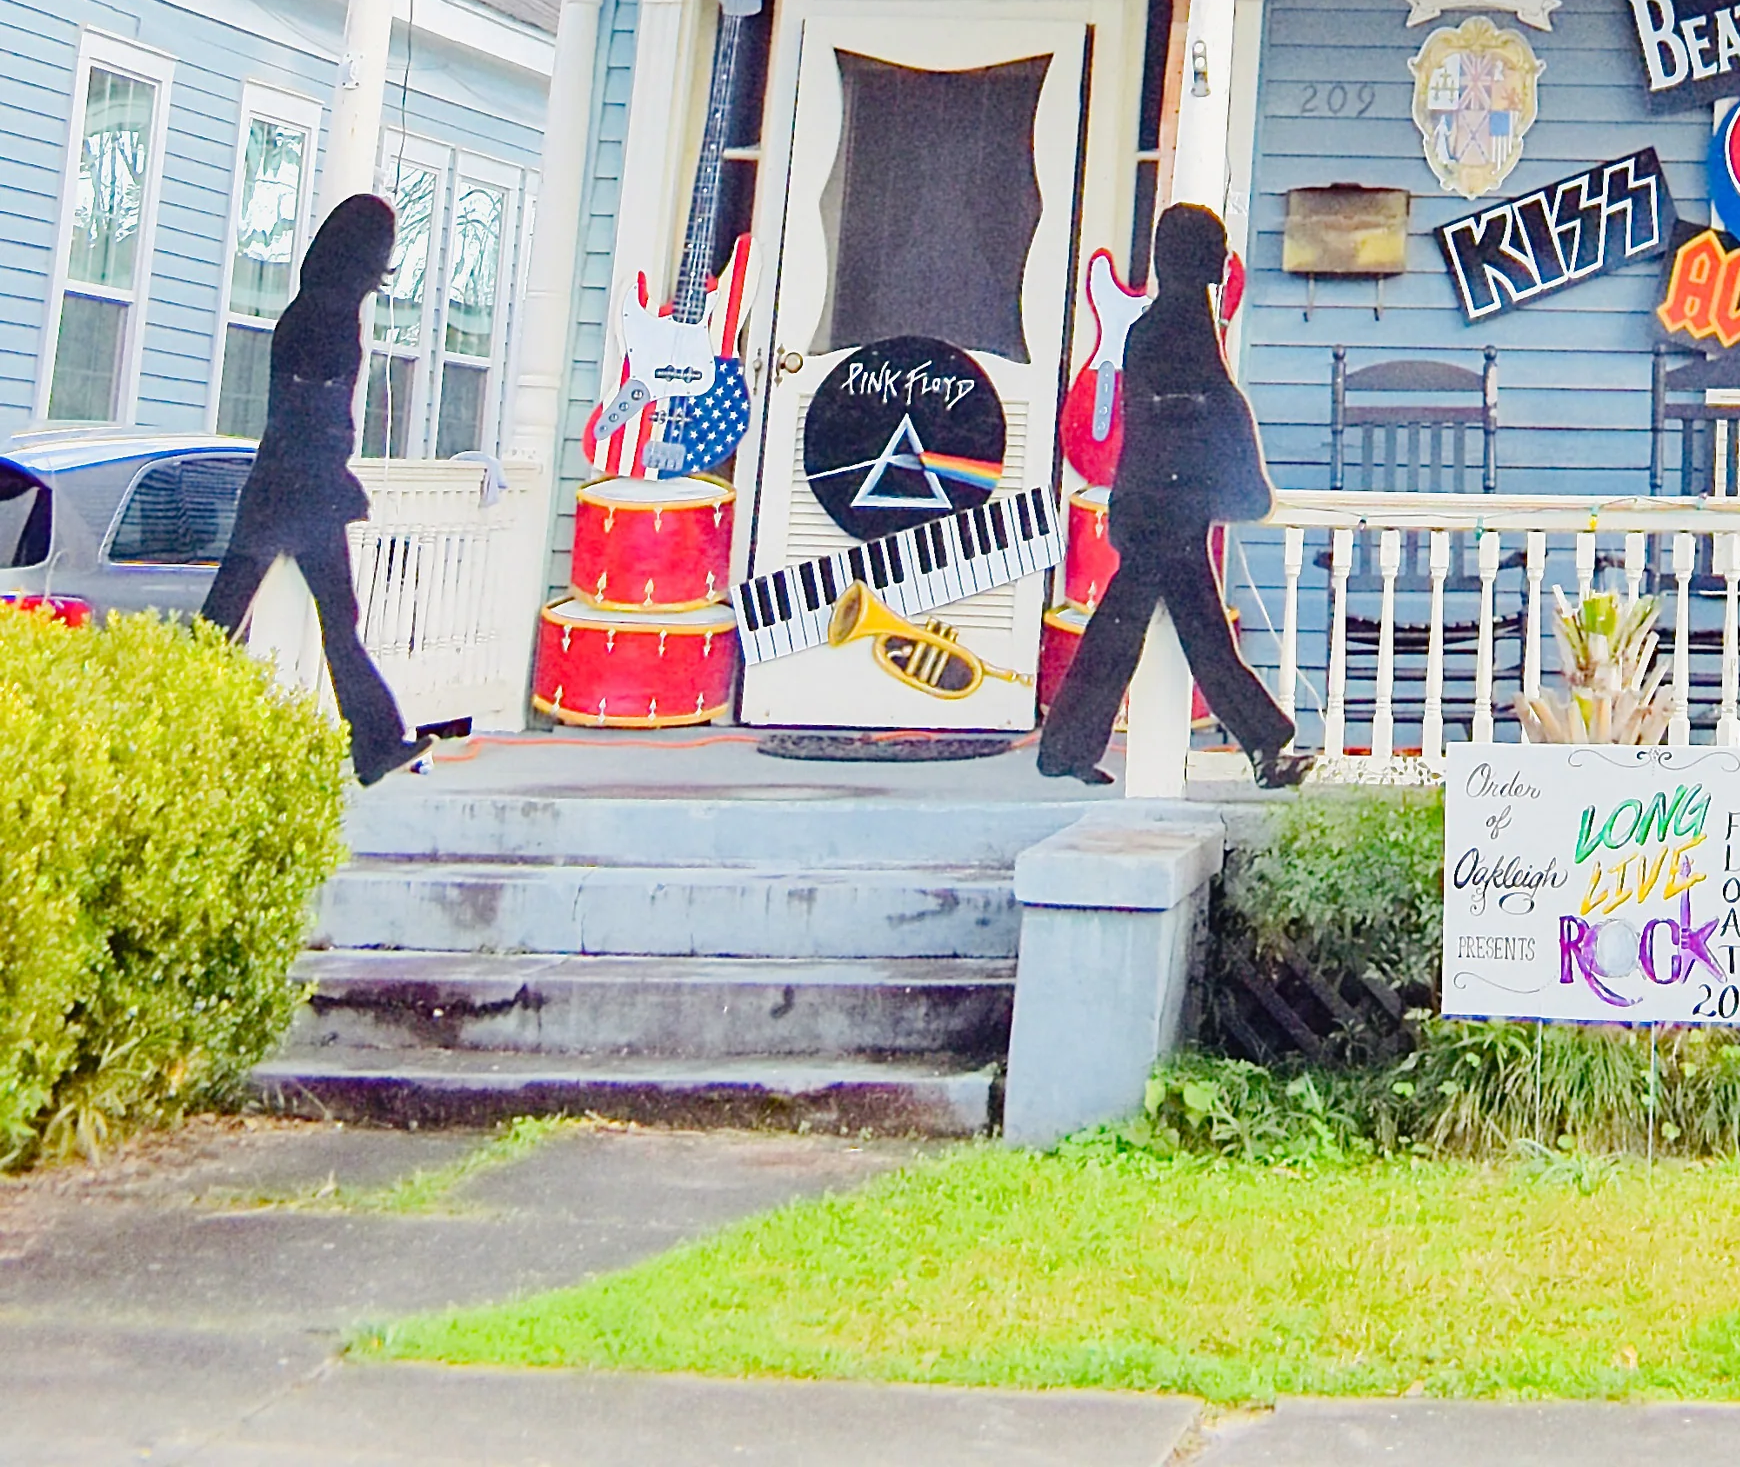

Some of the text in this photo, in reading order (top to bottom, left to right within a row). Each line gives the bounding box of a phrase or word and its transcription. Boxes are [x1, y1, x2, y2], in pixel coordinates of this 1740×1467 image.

[1301, 82, 1376, 118] 209
[1443, 157, 1660, 320] KISS
[840, 360, 975, 411] PINK FLOYD
[1466, 762, 1542, 799] Order
[1486, 805, 1512, 839] of
[1574, 783, 1712, 864] LONG
[1453, 848, 1568, 915] Oakleigh
[1580, 833, 1707, 915] LIVE
[1458, 935, 1536, 961] PRESENTS
[1559, 856, 1728, 1007] ROCK
